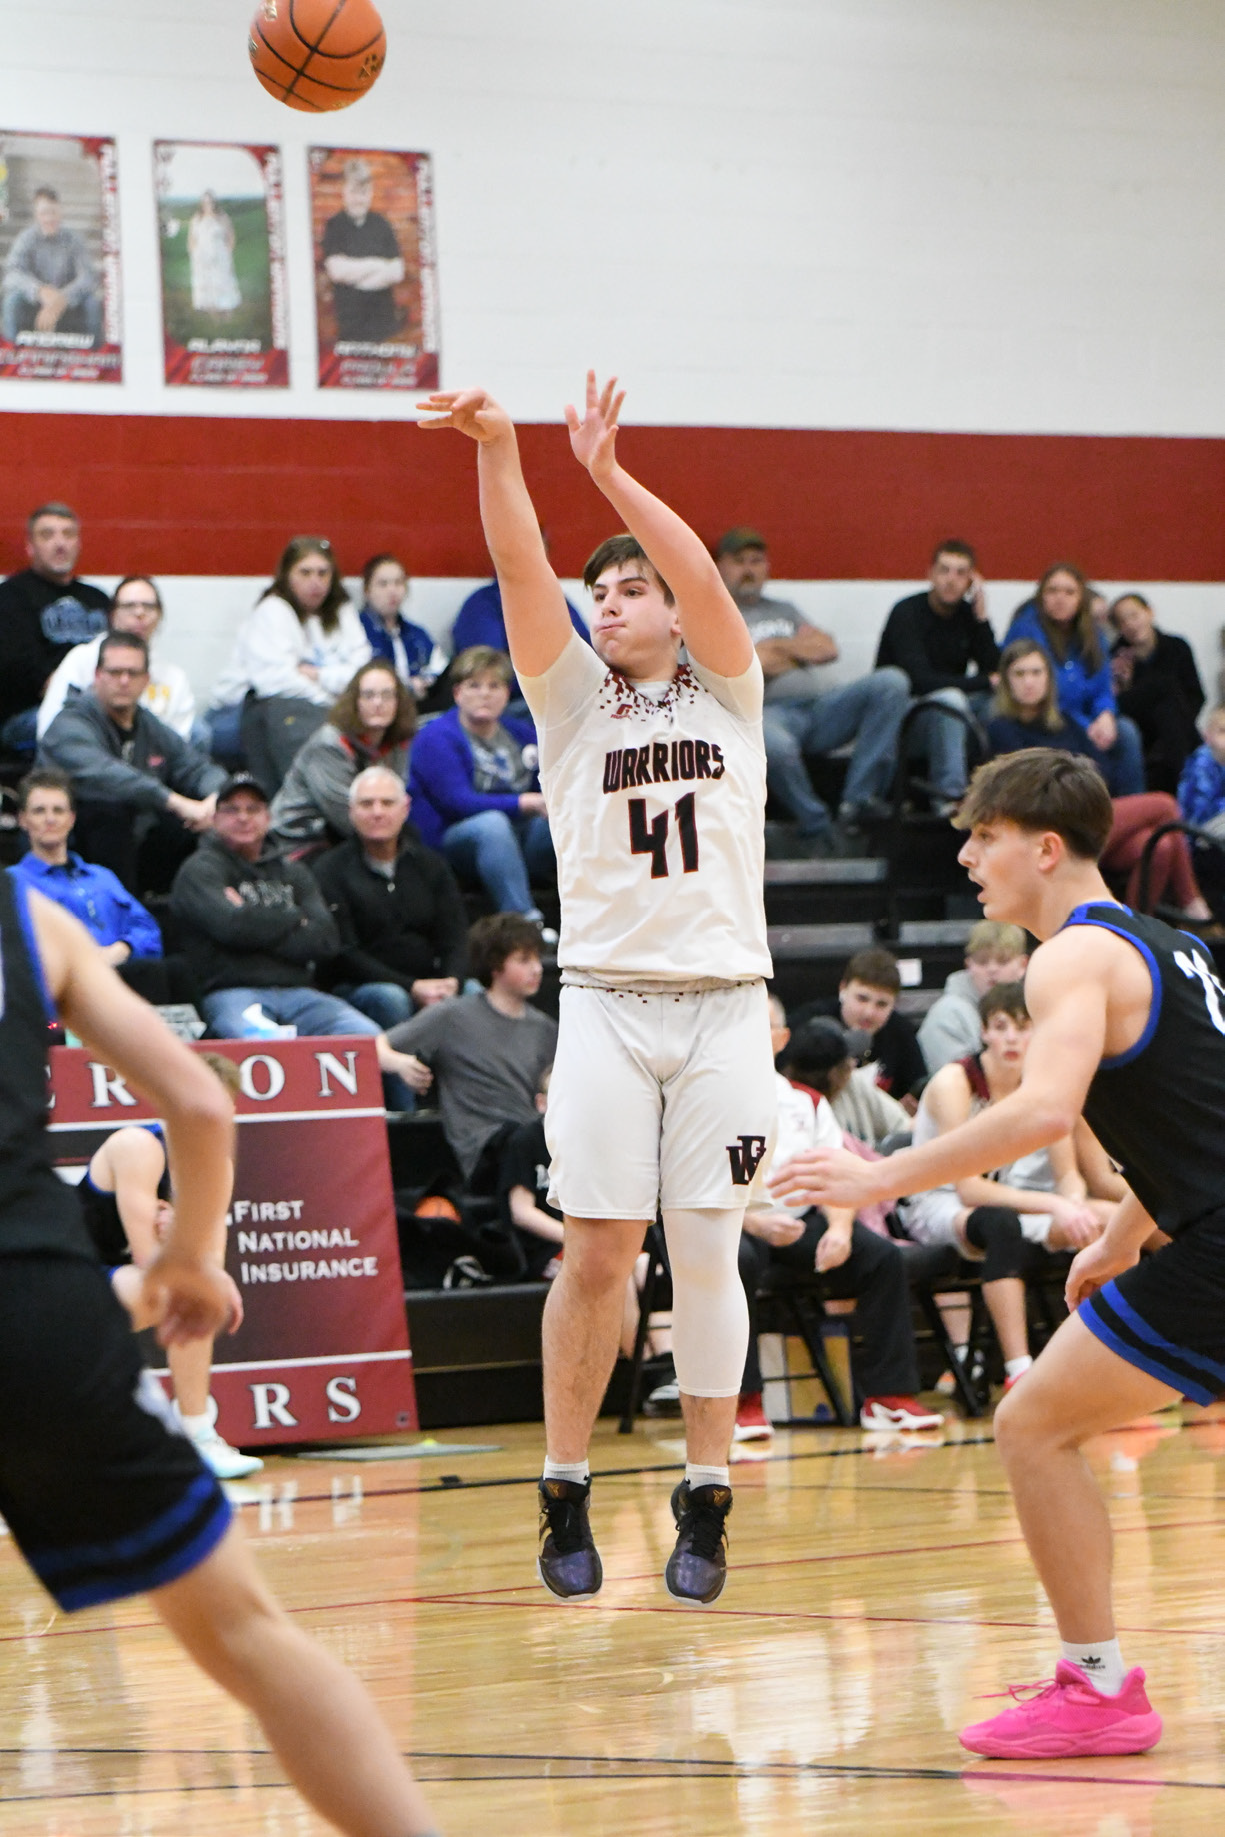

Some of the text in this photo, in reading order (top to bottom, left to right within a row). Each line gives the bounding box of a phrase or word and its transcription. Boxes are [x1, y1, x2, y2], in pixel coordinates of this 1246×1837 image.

[602, 739, 726, 795] WARRIORS
[627, 791, 699, 880] 41
[233, 1200, 304, 1223] FIRST
[237, 1228, 359, 1253] NATIONAL
[240, 1256, 378, 1284] INSURANCE
